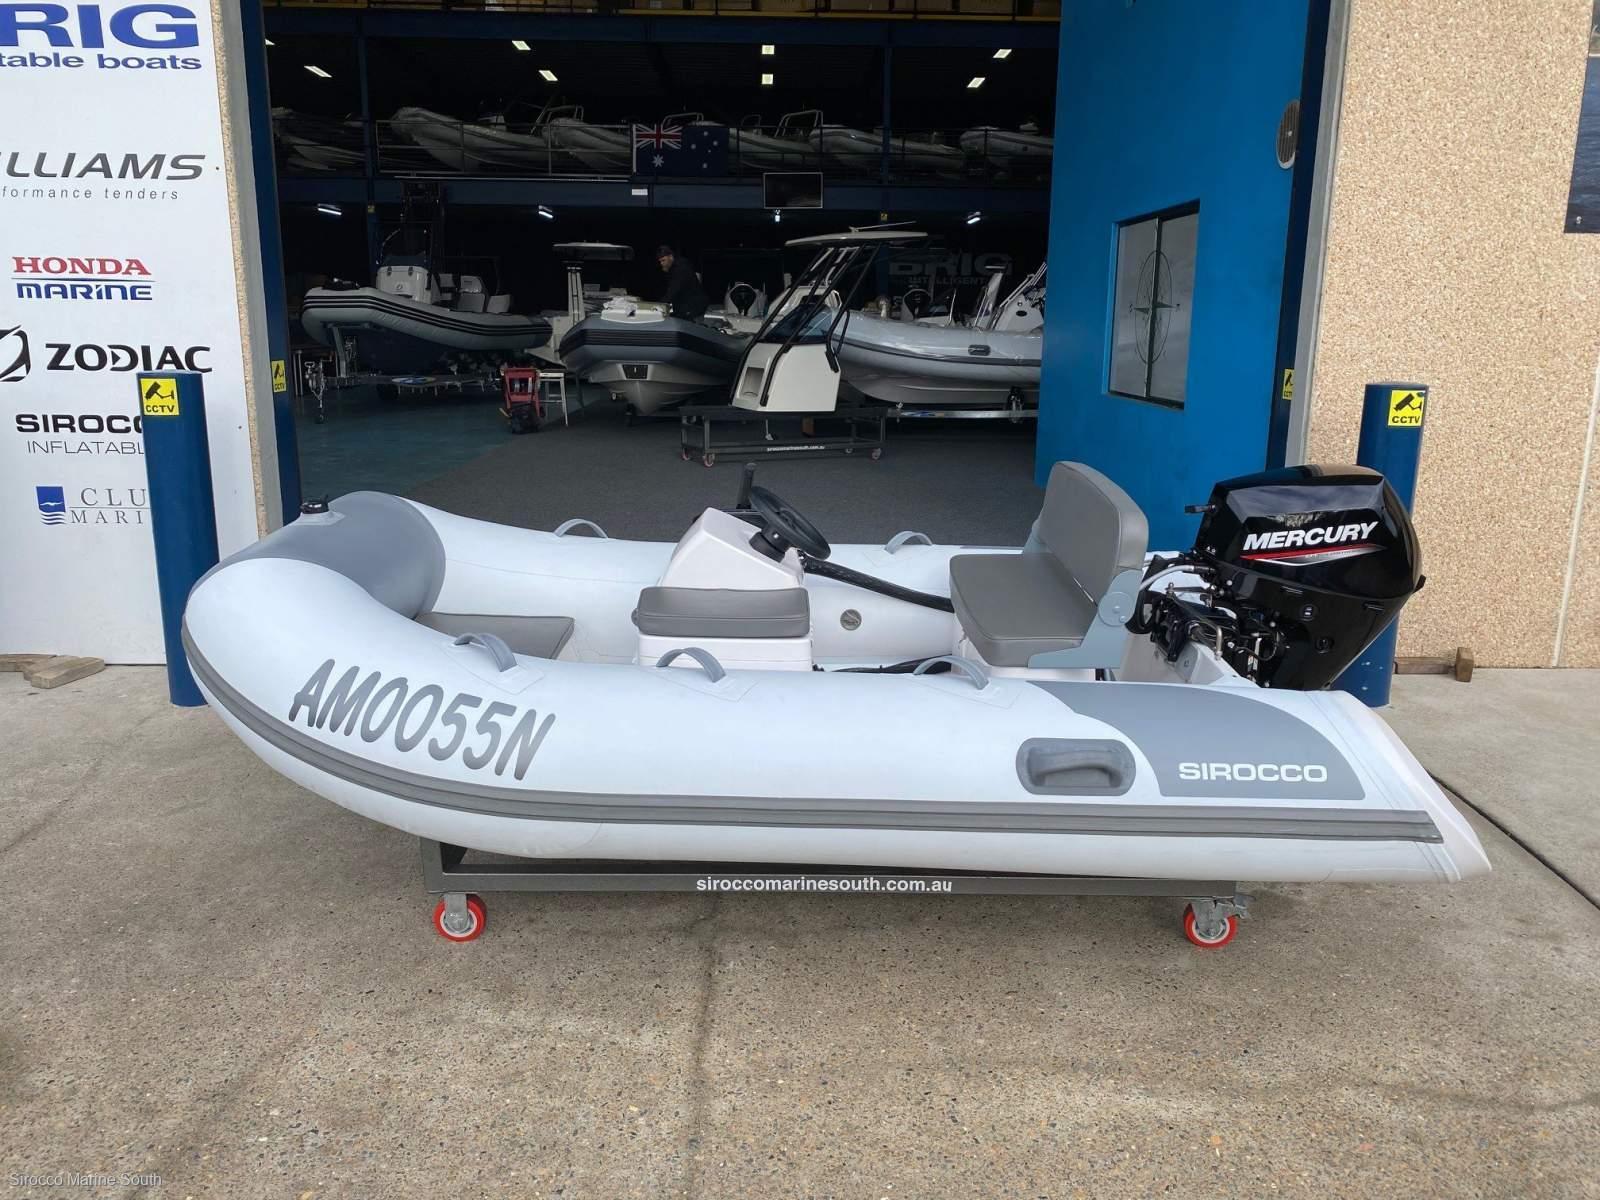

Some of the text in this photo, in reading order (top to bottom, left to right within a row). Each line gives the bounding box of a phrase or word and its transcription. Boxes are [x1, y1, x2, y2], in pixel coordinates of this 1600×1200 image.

[97, 53, 202, 70] boats
[0, 152, 206, 181] LLIAMS
[3, 186, 178, 200] formance tenders
[12, 257, 152, 276] HONDA
[45, 344, 213, 373] ZODIAC
[146, 405, 174, 413] CCTV
[1392, 416, 1420, 424] CCTV
[81, 488, 146, 507] CLU
[71, 510, 143, 524] MARI
[1243, 521, 1378, 550] MERCURY
[288, 658, 556, 781] AM0055N
[1178, 762, 1327, 783] SIROCCO
[696, 876, 952, 892] siroccomarinesouth.com.au
